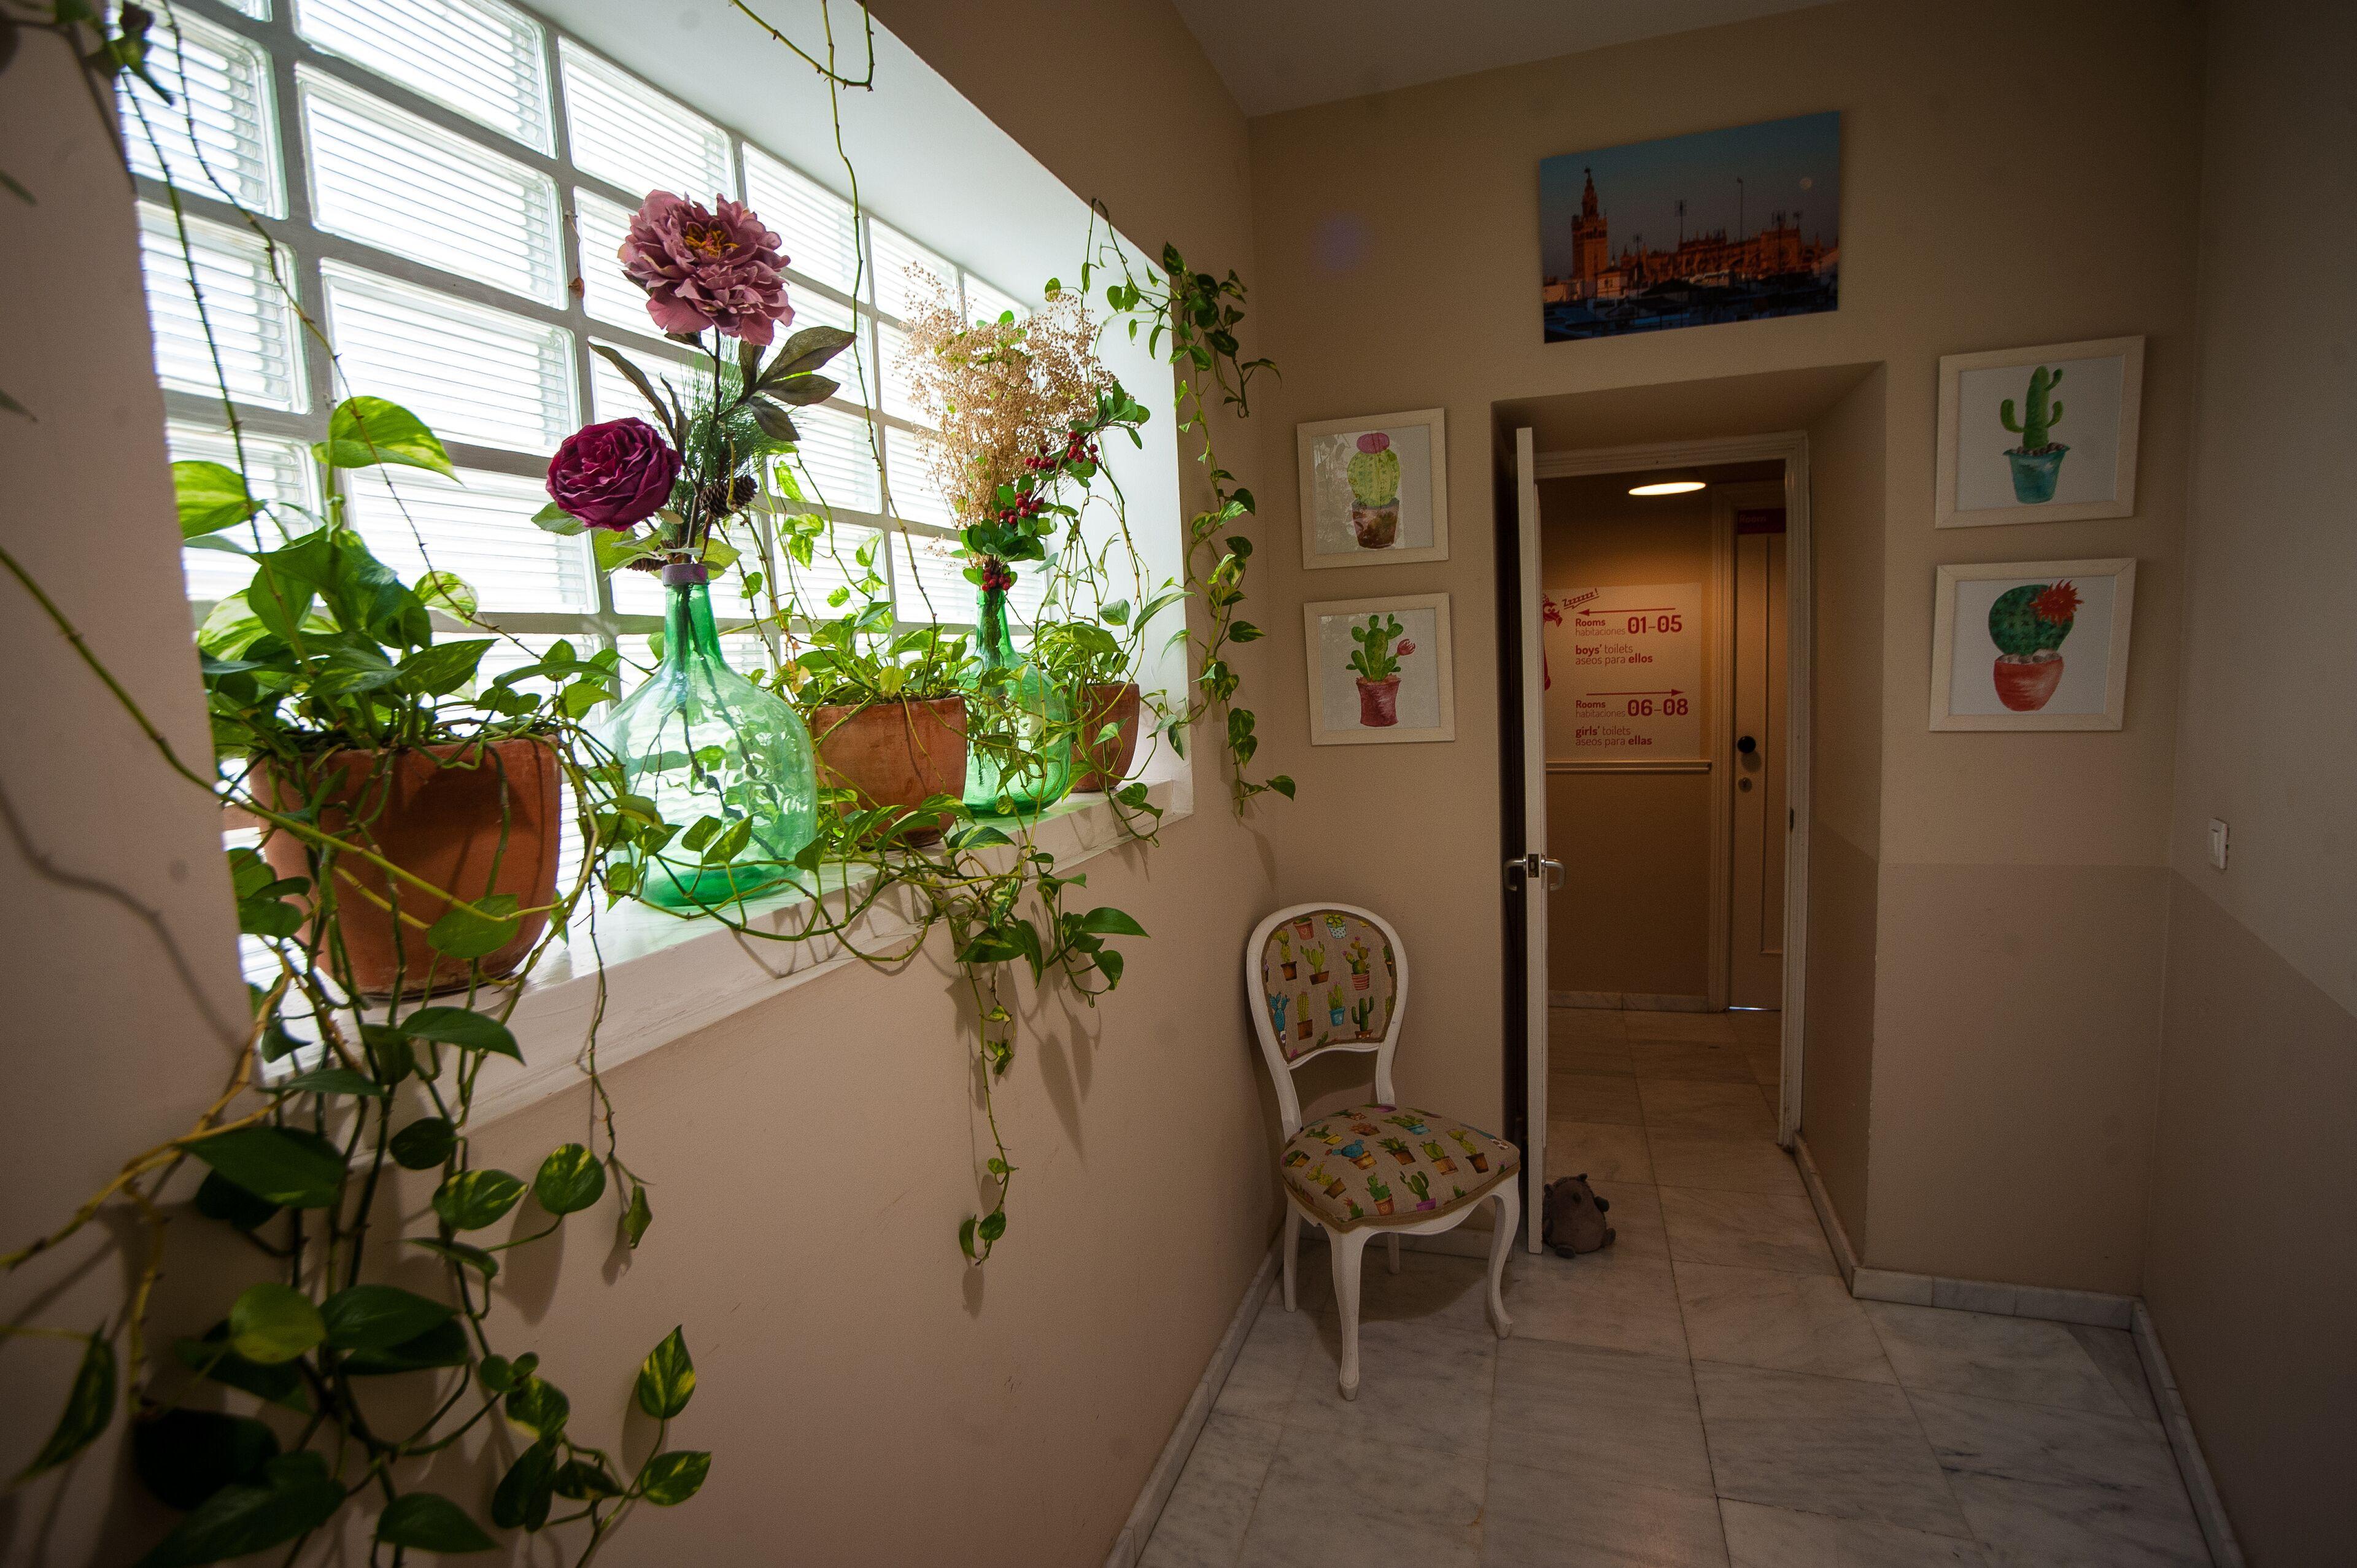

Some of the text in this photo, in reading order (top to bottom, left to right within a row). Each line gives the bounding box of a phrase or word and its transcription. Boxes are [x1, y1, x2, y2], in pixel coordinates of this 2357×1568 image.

[1576, 618, 1606, 627] Rooms
[1576, 627, 1625, 636] habitaciones
[1576, 643, 1633, 657] boys' toilets
[1604, 656, 1625, 666] para
[1628, 653, 1653, 663] ellos
[1576, 709, 1625, 717] habitaciones
[1576, 725, 1631, 738] girls' toilets
[1604, 738, 1625, 748] para
[1628, 735, 1652, 745] ellas
